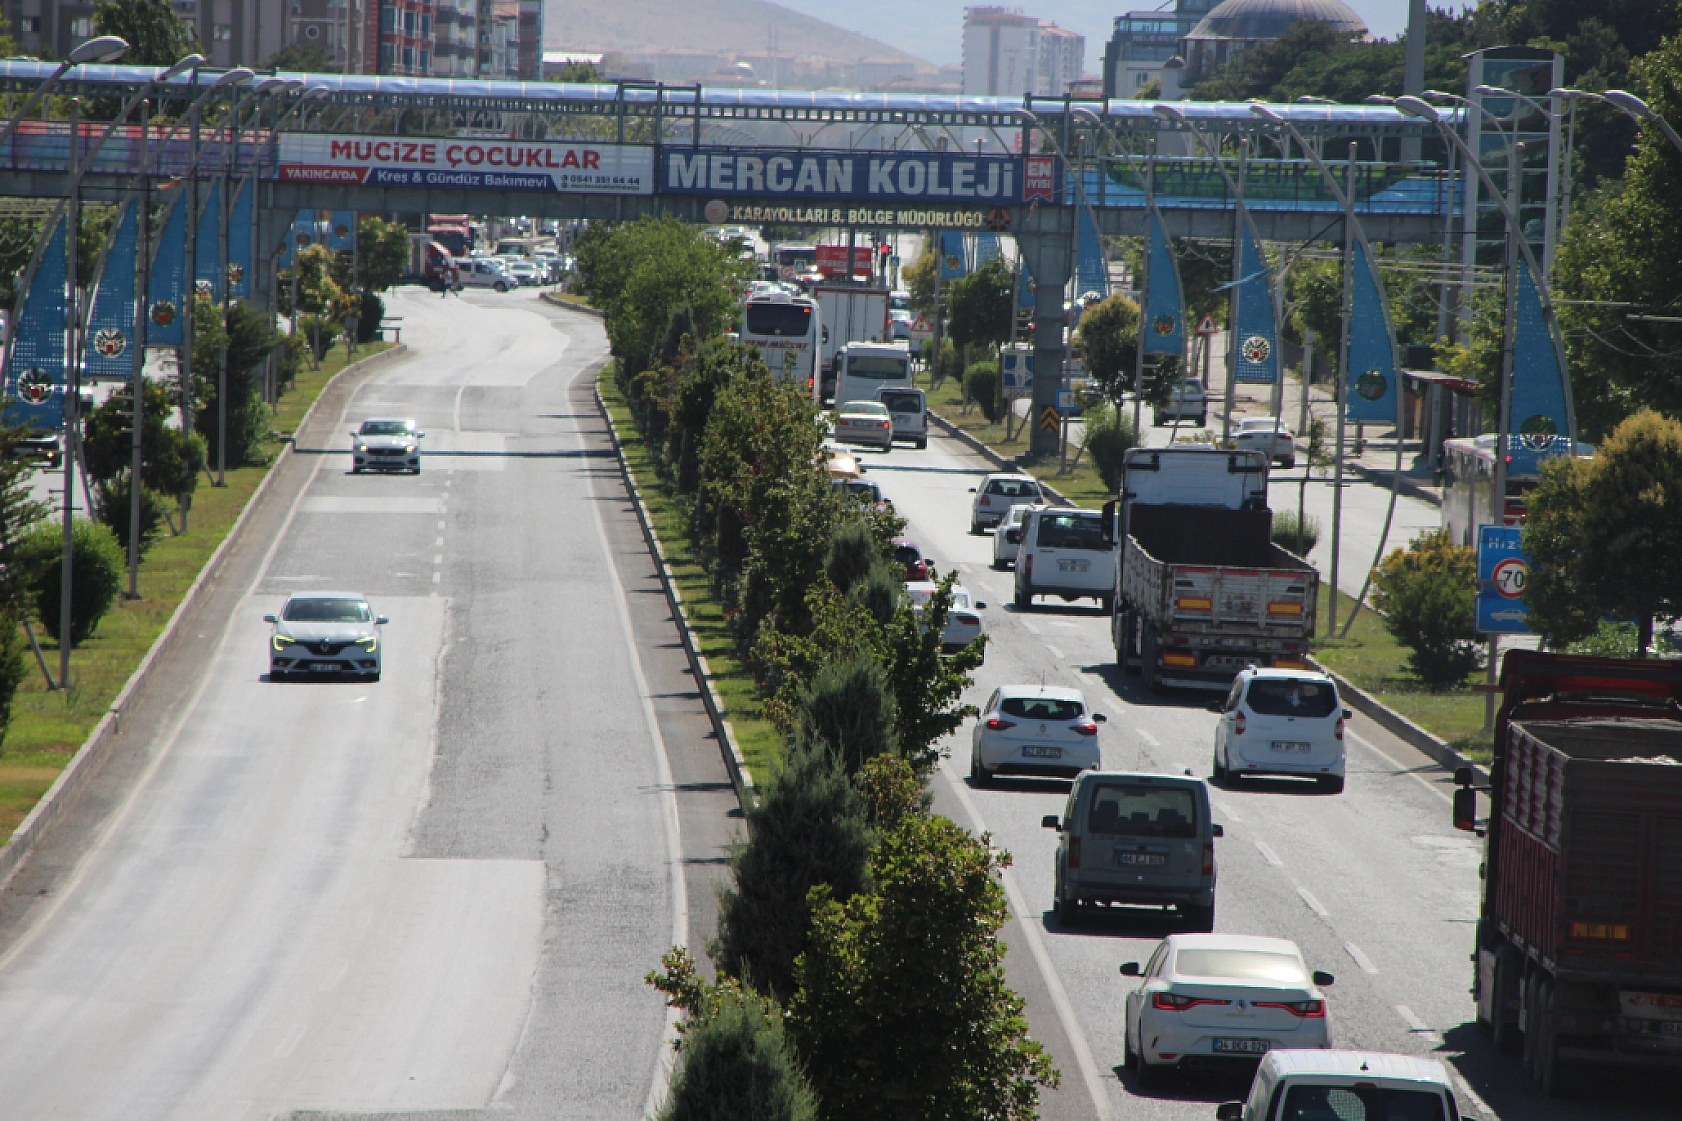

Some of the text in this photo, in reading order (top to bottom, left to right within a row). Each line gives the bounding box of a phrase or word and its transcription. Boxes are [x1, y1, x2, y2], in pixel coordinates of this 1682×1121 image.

[445, 144, 600, 170] ÇOCUKLAR
[286, 167, 358, 181] YAKINCA'DA
[426, 171, 480, 185] Gündüz
[668, 153, 853, 194] MERCAN
[1028, 161, 1052, 177] EN
[733, 205, 828, 223] KARAYOLLARI
[831, 208, 844, 223] 8.
[847, 205, 894, 225] BÖLGE
[1501, 569, 1524, 588] 70
